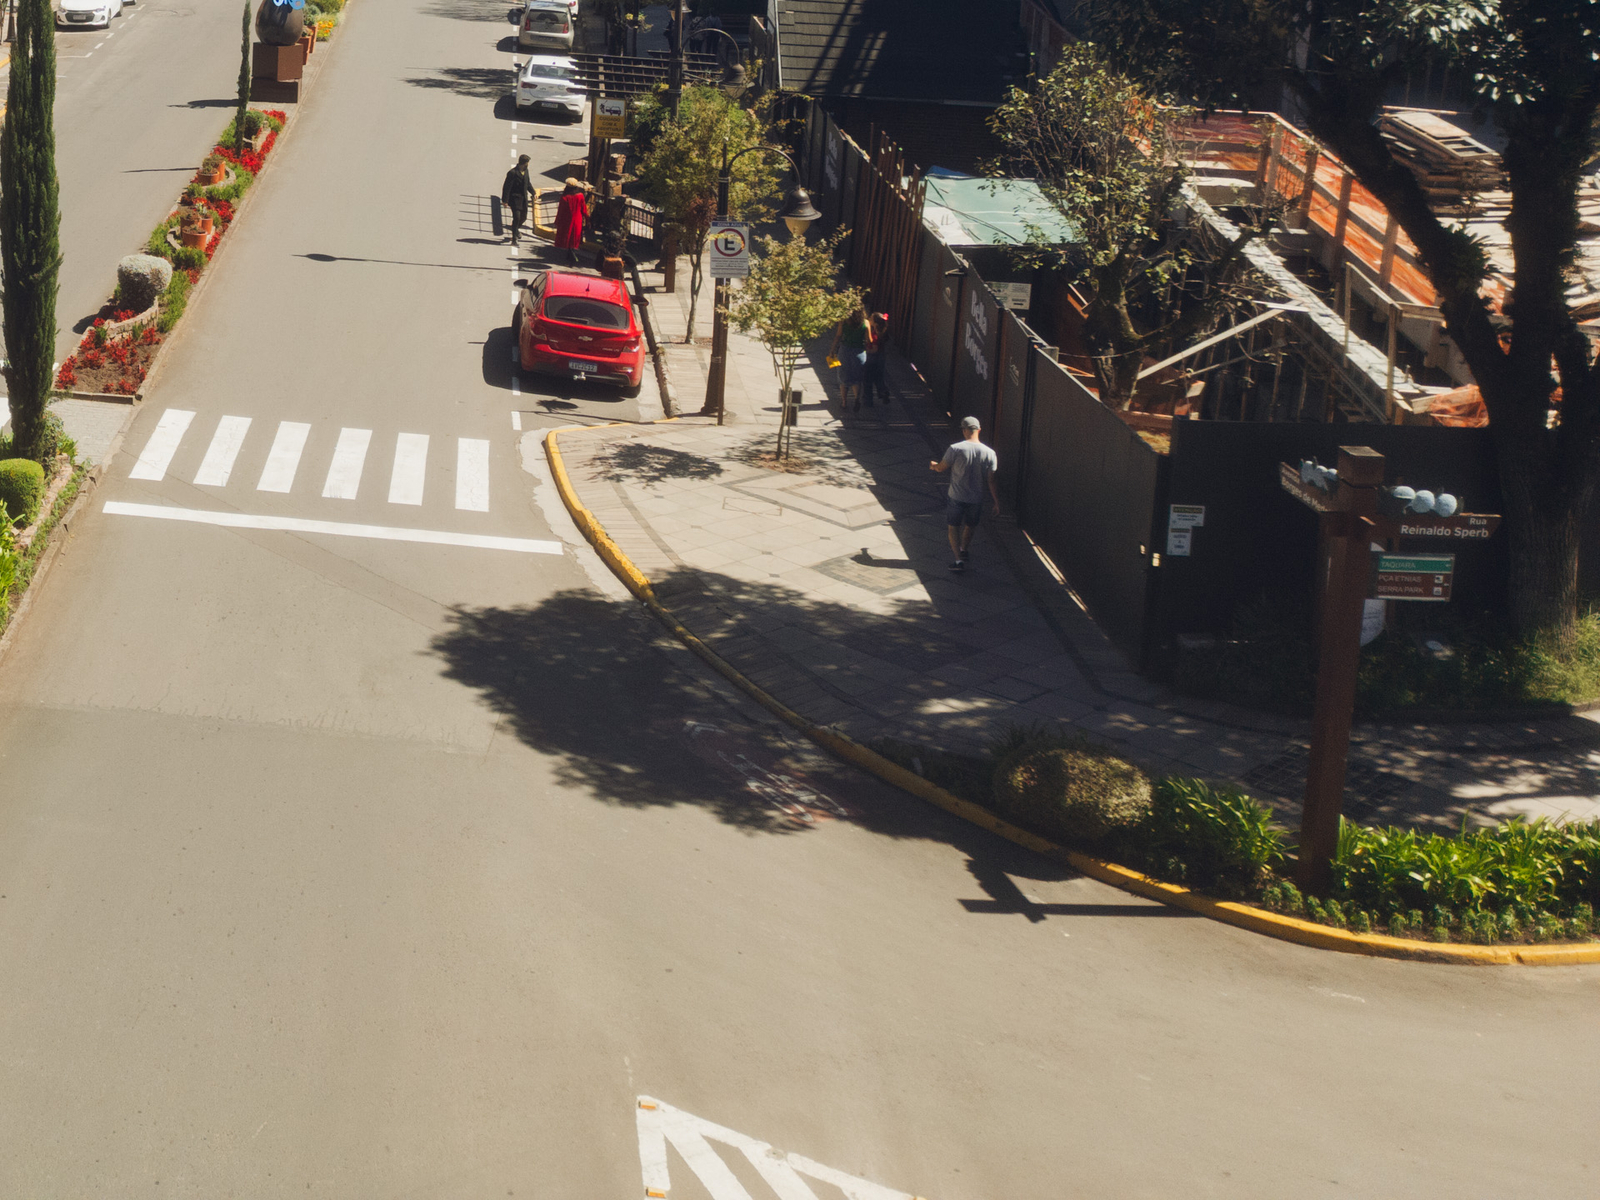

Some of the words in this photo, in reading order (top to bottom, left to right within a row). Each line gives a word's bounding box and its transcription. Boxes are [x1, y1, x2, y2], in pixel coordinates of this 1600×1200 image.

[725, 234, 735, 250] E
[971, 289, 988, 337] Bella
[965, 321, 989, 381] Borges
[1281, 476, 1303, 498] Borges
[1303, 493, 1311, 504] de
[1469, 517, 1487, 525] Rua
[1401, 524, 1451, 536] Reinaldo
[1454, 526, 1489, 538] Sperb
[1381, 561, 1416, 569] TAQUARA
[1379, 574, 1394, 583] PÇA
[1395, 575, 1422, 583] ETNIAS
[1378, 585, 1403, 593] SERRA
